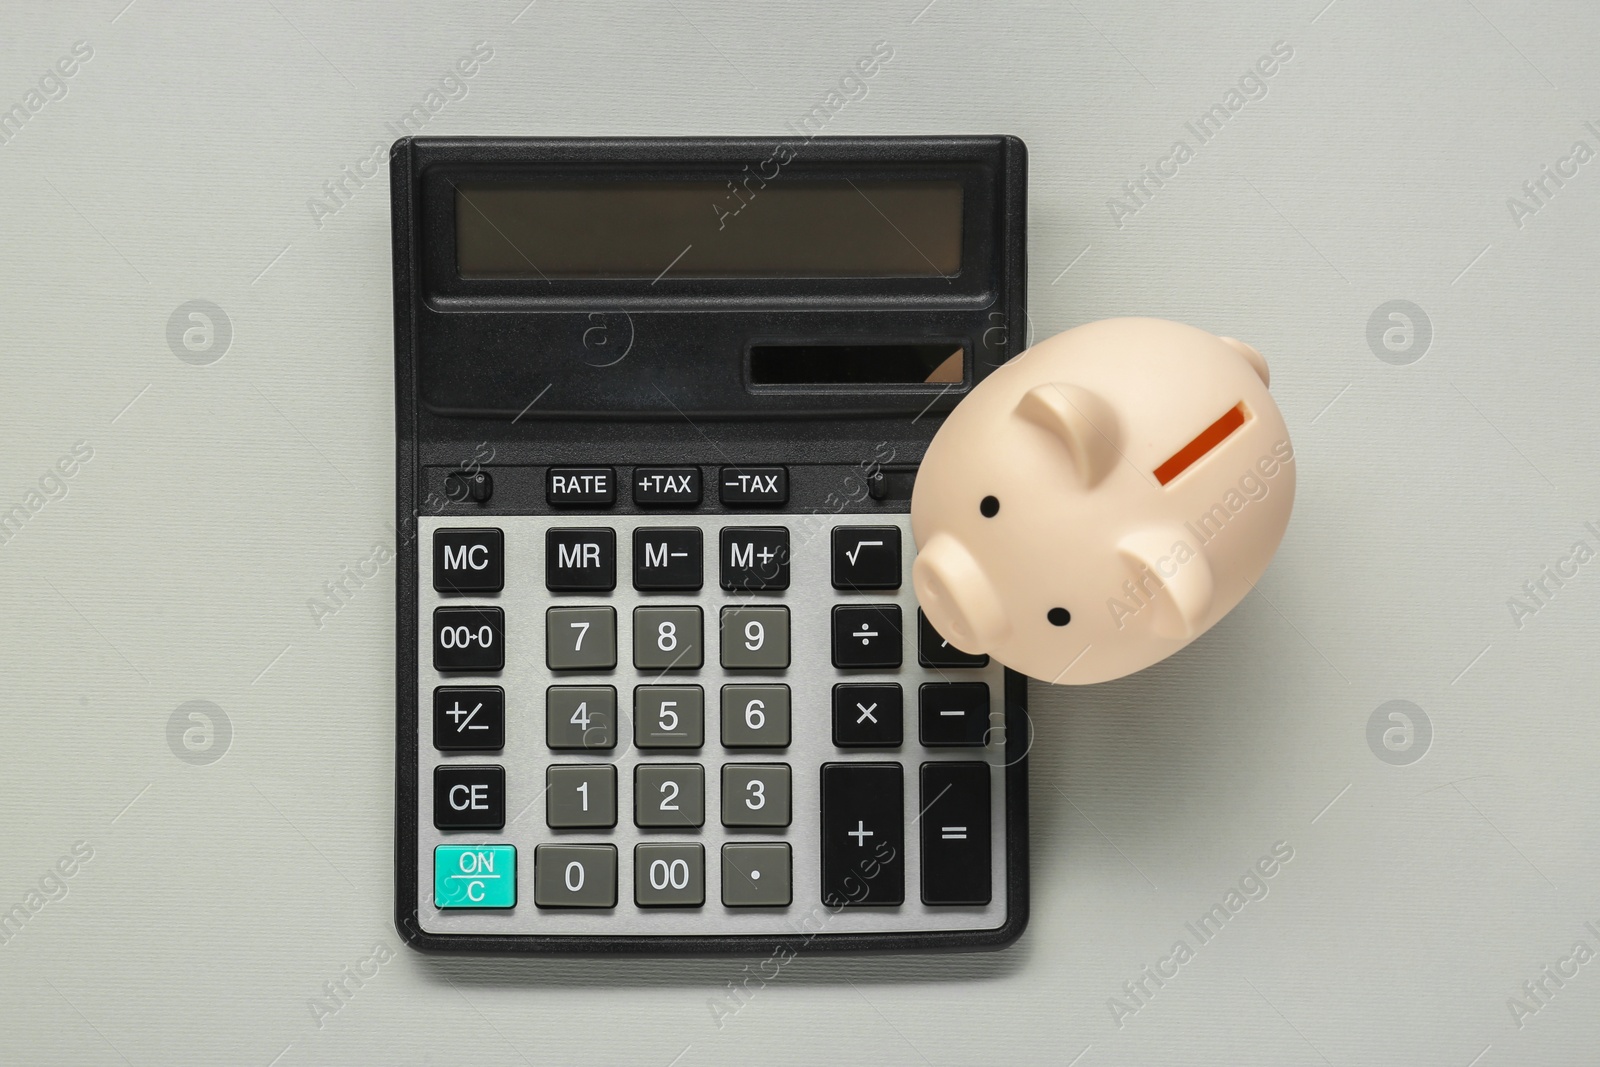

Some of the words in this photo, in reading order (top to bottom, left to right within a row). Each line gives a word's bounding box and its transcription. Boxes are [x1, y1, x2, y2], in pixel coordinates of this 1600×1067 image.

[552, 475, 607, 493] RATE
[638, 475, 692, 493] +TAX
[444, 544, 489, 570] MC
[558, 543, 601, 568] MR
[731, 542, 774, 568] M+
[570, 622, 590, 651] 7
[657, 621, 677, 651] 8
[744, 620, 765, 651] 9
[570, 701, 591, 731] 4
[658, 701, 679, 731] 5
[745, 699, 766, 730] 6
[449, 784, 488, 811] CE
[576, 781, 588, 812] 1
[659, 780, 680, 811] 2
[745, 779, 766, 810] 3
[459, 851, 494, 873] ON
[564, 861, 585, 892] 0
[649, 858, 690, 890] 00
[467, 881, 485, 902] C
